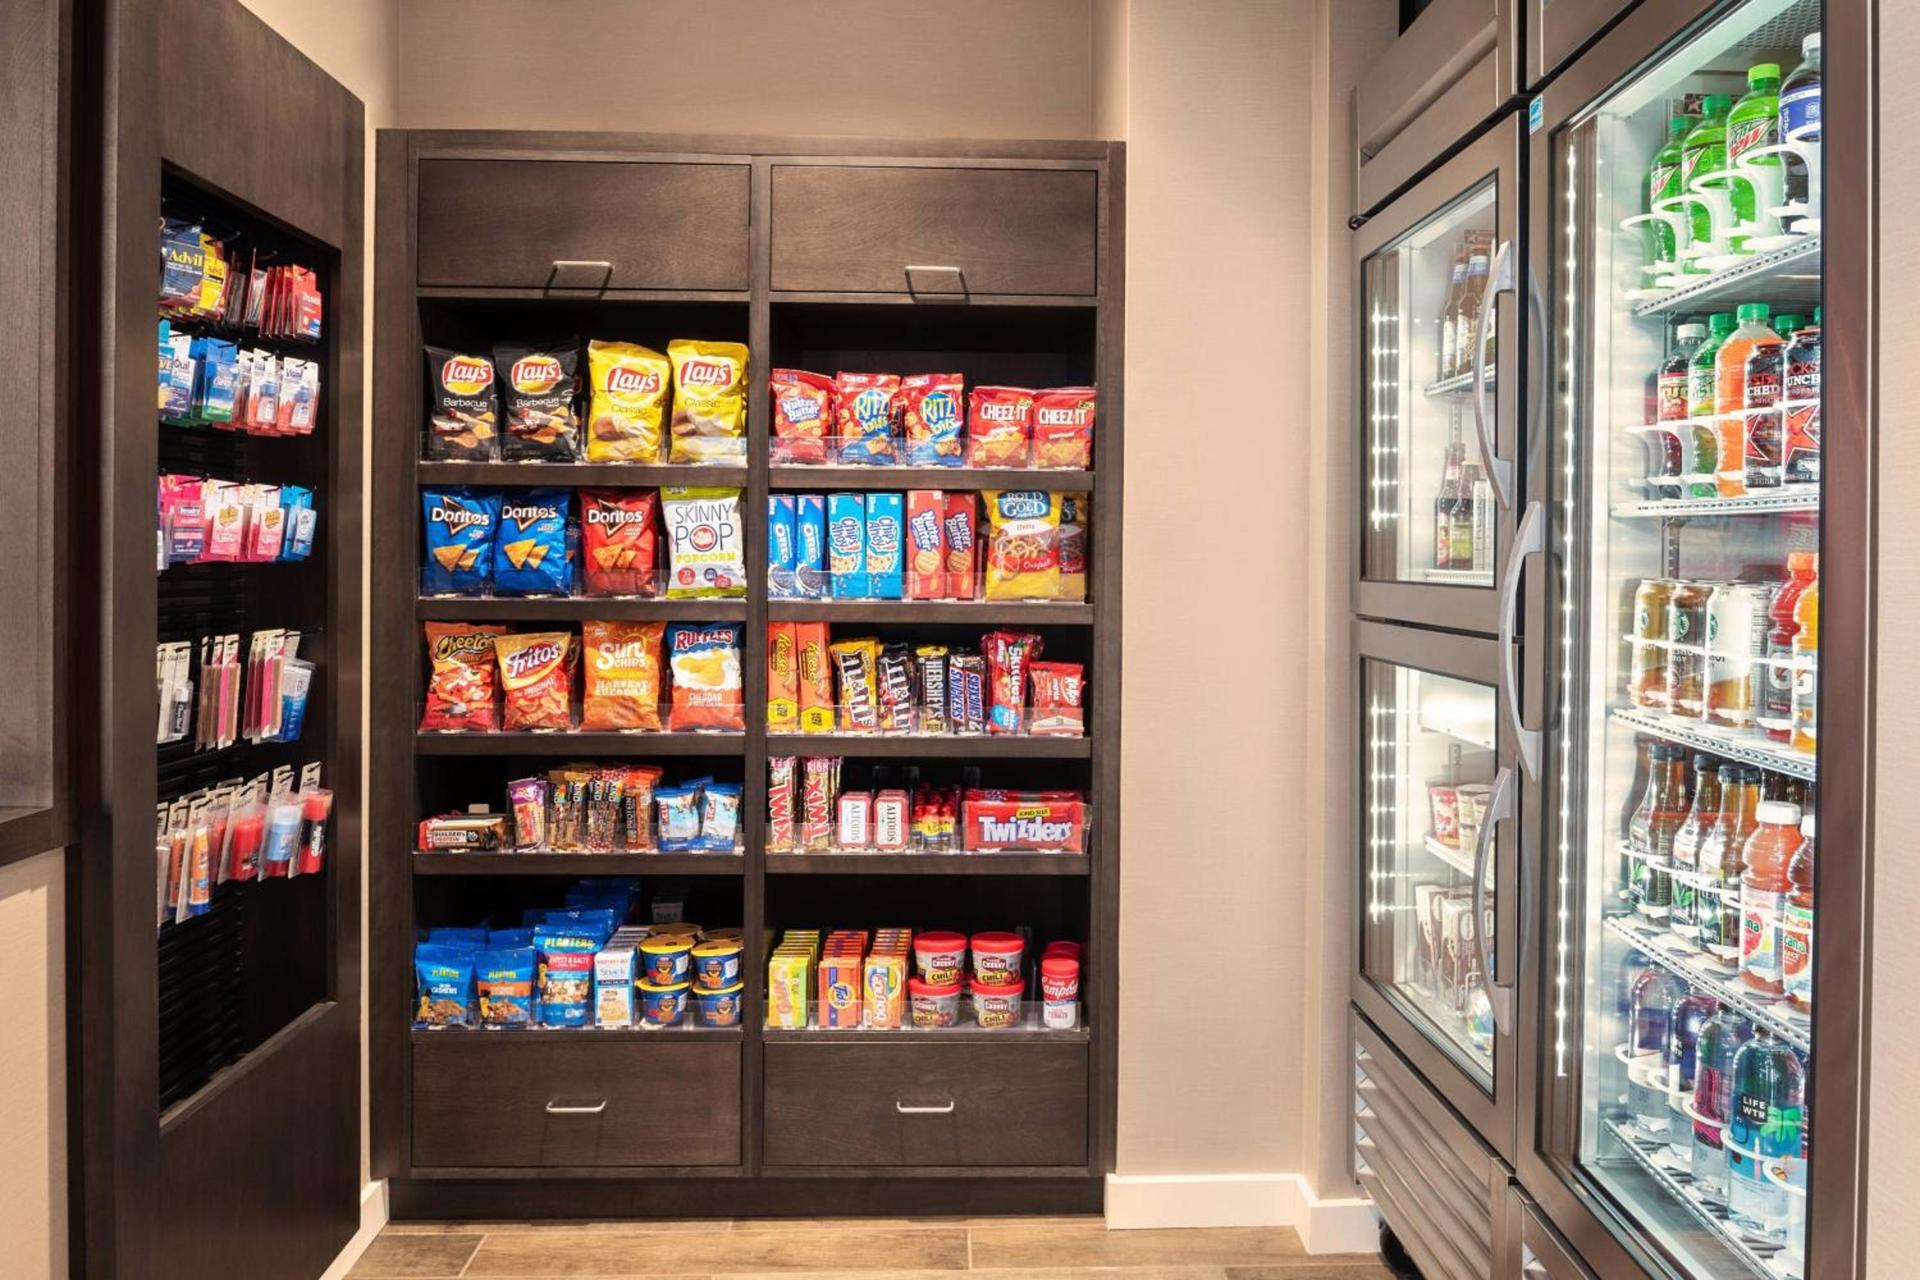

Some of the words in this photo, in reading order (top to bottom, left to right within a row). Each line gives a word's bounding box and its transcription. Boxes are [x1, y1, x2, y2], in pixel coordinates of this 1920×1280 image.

[169, 249, 202, 266] Advil
[443, 397, 487, 408] Barbecue
[684, 398, 720, 409] Classic
[857, 397, 888, 421] RITZ
[922, 398, 955, 425] RITZ
[1007, 492, 1044, 502] ROLD
[431, 507, 490, 526] Doritos
[502, 505, 557, 519] Doritos
[588, 508, 644, 523] Doritos
[675, 503, 732, 524] SKINNY
[1003, 501, 1047, 517] GOLD
[911, 516, 932, 551] Butter
[921, 509, 940, 547] Nutter
[945, 517, 964, 552] Butter
[956, 511, 972, 547] Nutter
[675, 523, 734, 553] POP
[675, 552, 737, 563] POPCORN
[674, 630, 733, 650] RUFFLES
[506, 643, 560, 678] Fritos
[614, 658, 648, 668] CHIPS
[951, 669, 965, 720] SNICKERS
[967, 673, 982, 719] SNICKERS
[626, 797, 635, 829] PROTEIN
[979, 816, 1073, 843] Twizzlers
[931, 971, 953, 980] CHILI
[982, 973, 1003, 981] CHILI
[431, 986, 458, 994] CASHEWS
[872, 972, 889, 1022] Bounce
[984, 1014, 1005, 1023] CHILI
[1743, 1095, 1766, 1109] LIFE
[1743, 1105, 1766, 1120] WTR
